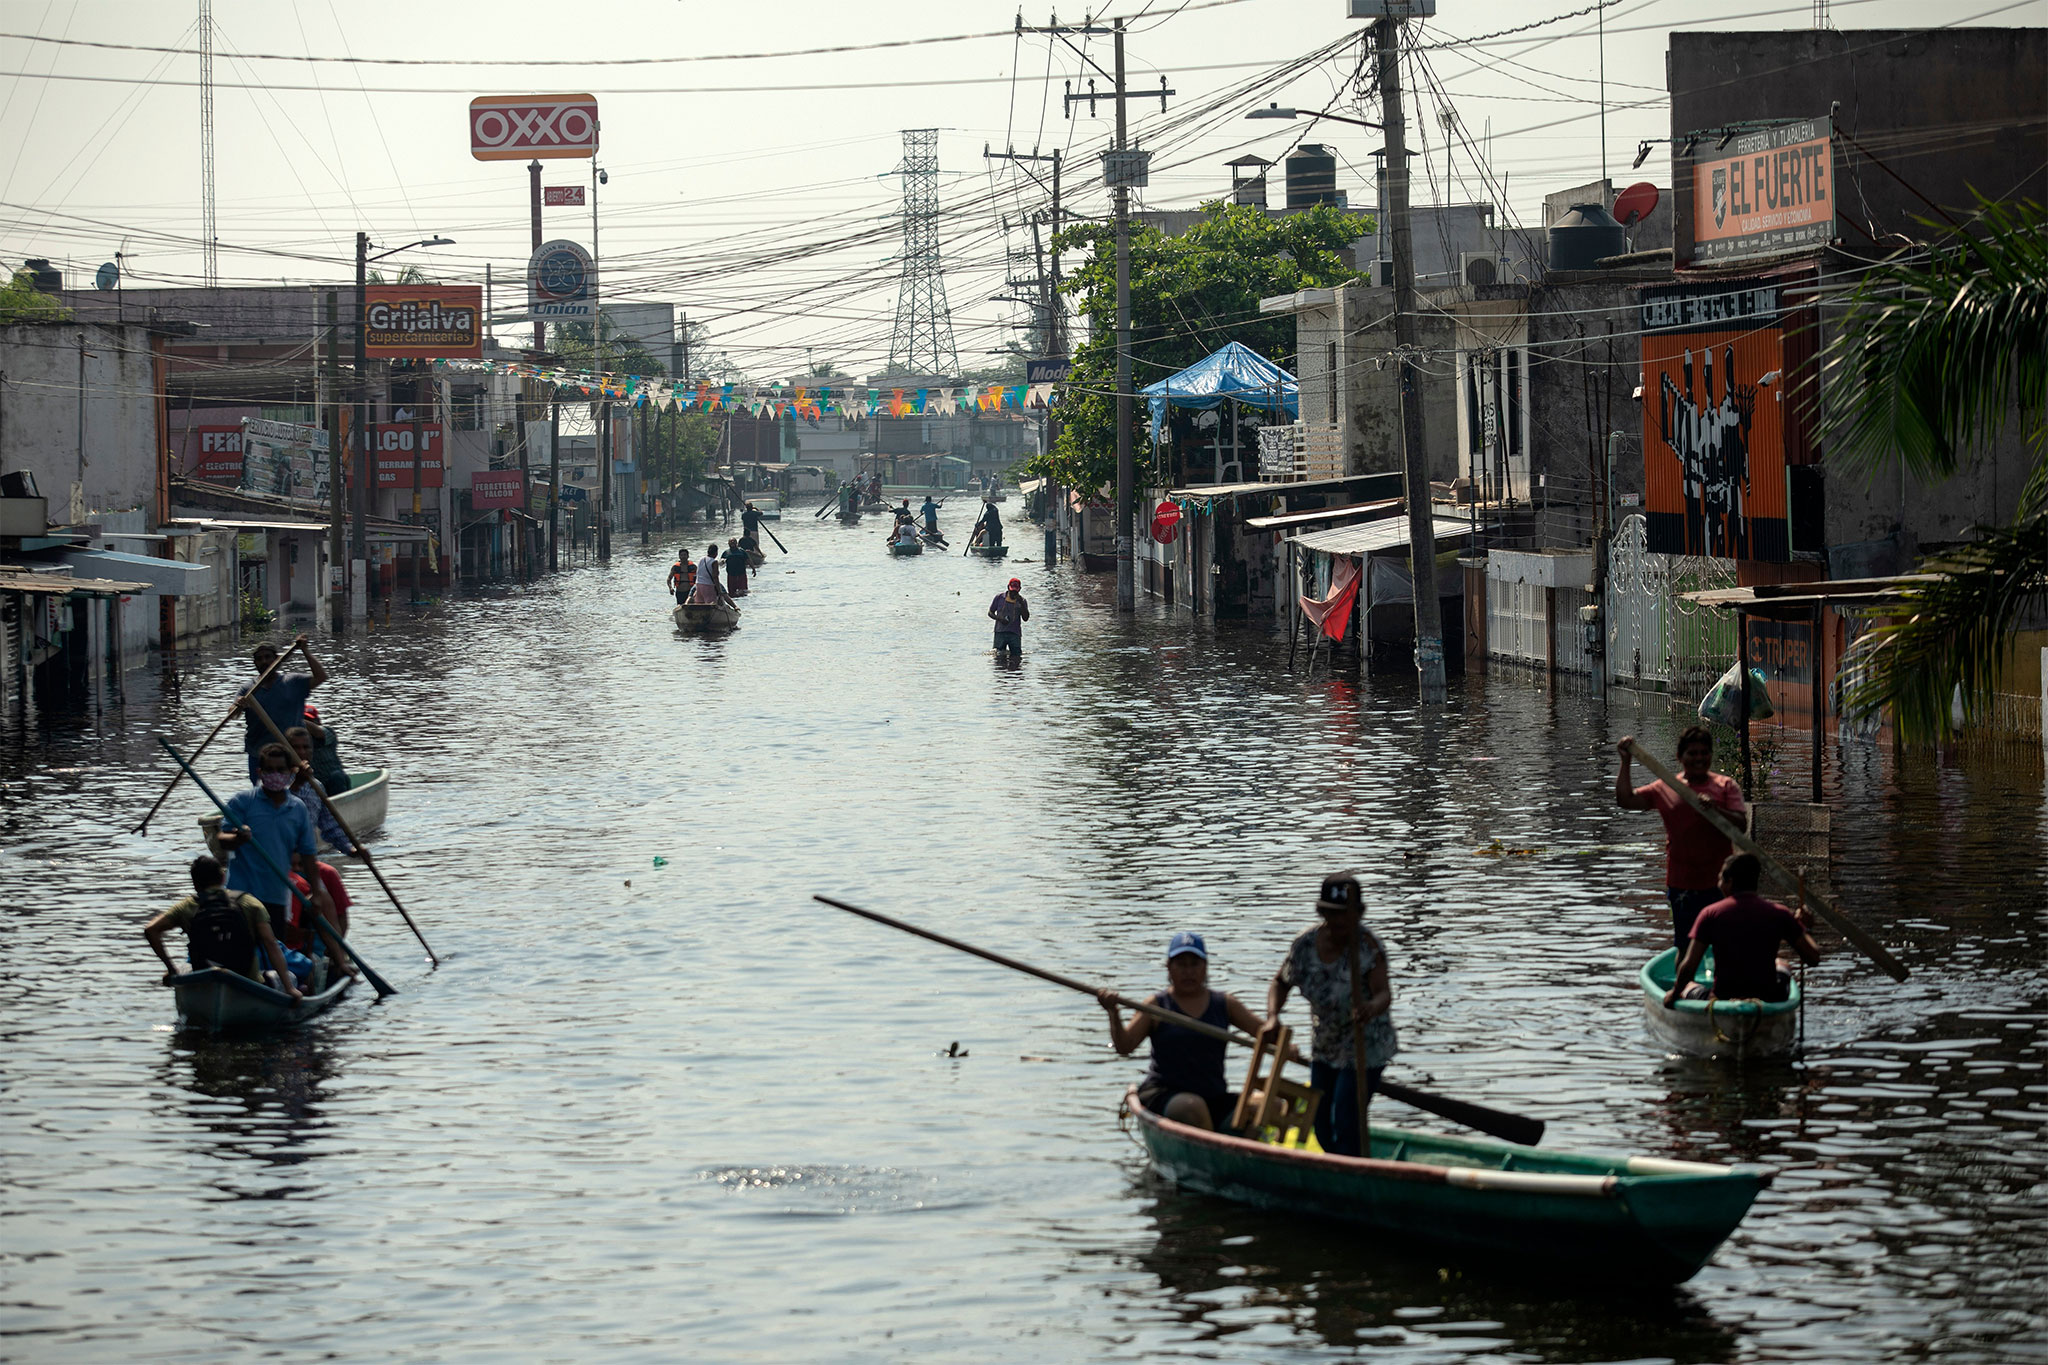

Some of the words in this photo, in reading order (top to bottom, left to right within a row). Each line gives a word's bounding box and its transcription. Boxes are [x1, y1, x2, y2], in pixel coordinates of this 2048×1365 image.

[475, 105, 593, 147] OXXO
[1772, 131, 1777, 145] Y
[1730, 160, 1751, 216] EL
[1754, 144, 1826, 212] FUERTE
[565, 188, 582, 199] 24
[534, 302, 589, 315] Unión
[369, 304, 470, 333] Grijalva
[369, 330, 471, 344] supercarnicerías
[1030, 365, 1071, 381] Mode
[379, 473, 396, 481] GAS
[1765, 637, 1807, 668] TRUPER
